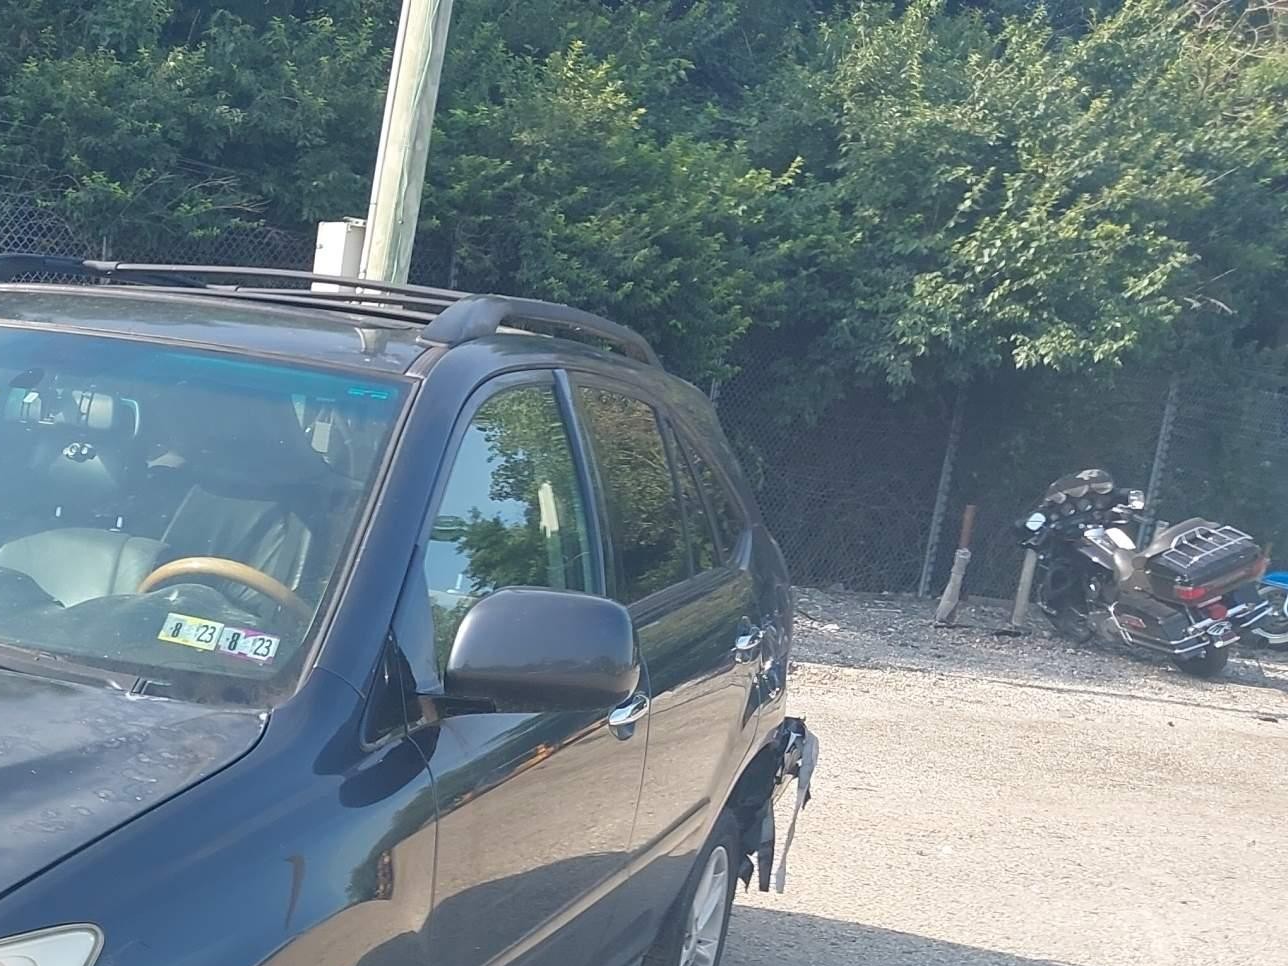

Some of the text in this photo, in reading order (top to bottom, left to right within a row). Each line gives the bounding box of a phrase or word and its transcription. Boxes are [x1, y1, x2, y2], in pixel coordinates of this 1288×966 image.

[171, 622, 217, 643] 8 23
[227, 632, 273, 657] 8 23
